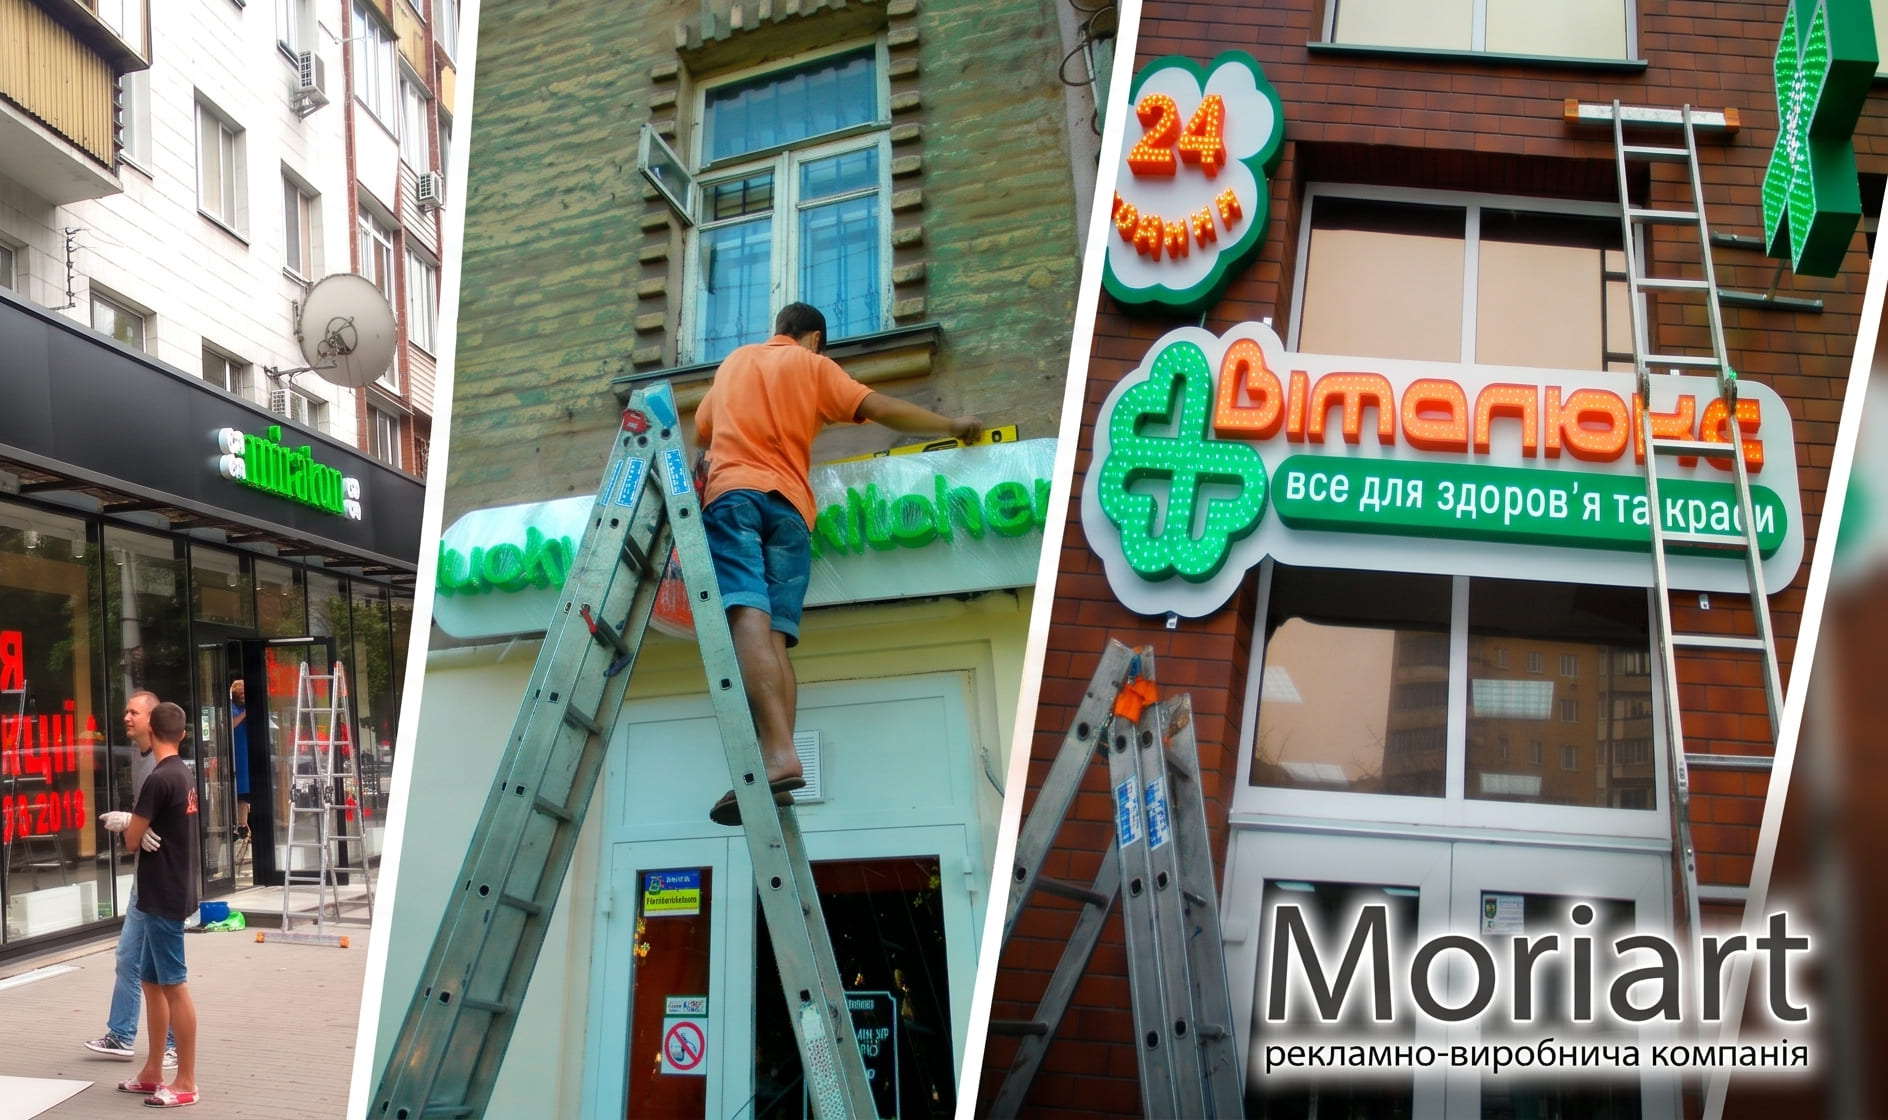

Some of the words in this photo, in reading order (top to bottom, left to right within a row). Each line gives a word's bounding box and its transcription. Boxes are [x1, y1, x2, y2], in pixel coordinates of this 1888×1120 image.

[1126, 94, 1227, 178] 24
[1285, 469, 1350, 503] все
[1358, 474, 1423, 511] для
[1612, 493, 1651, 526] та
